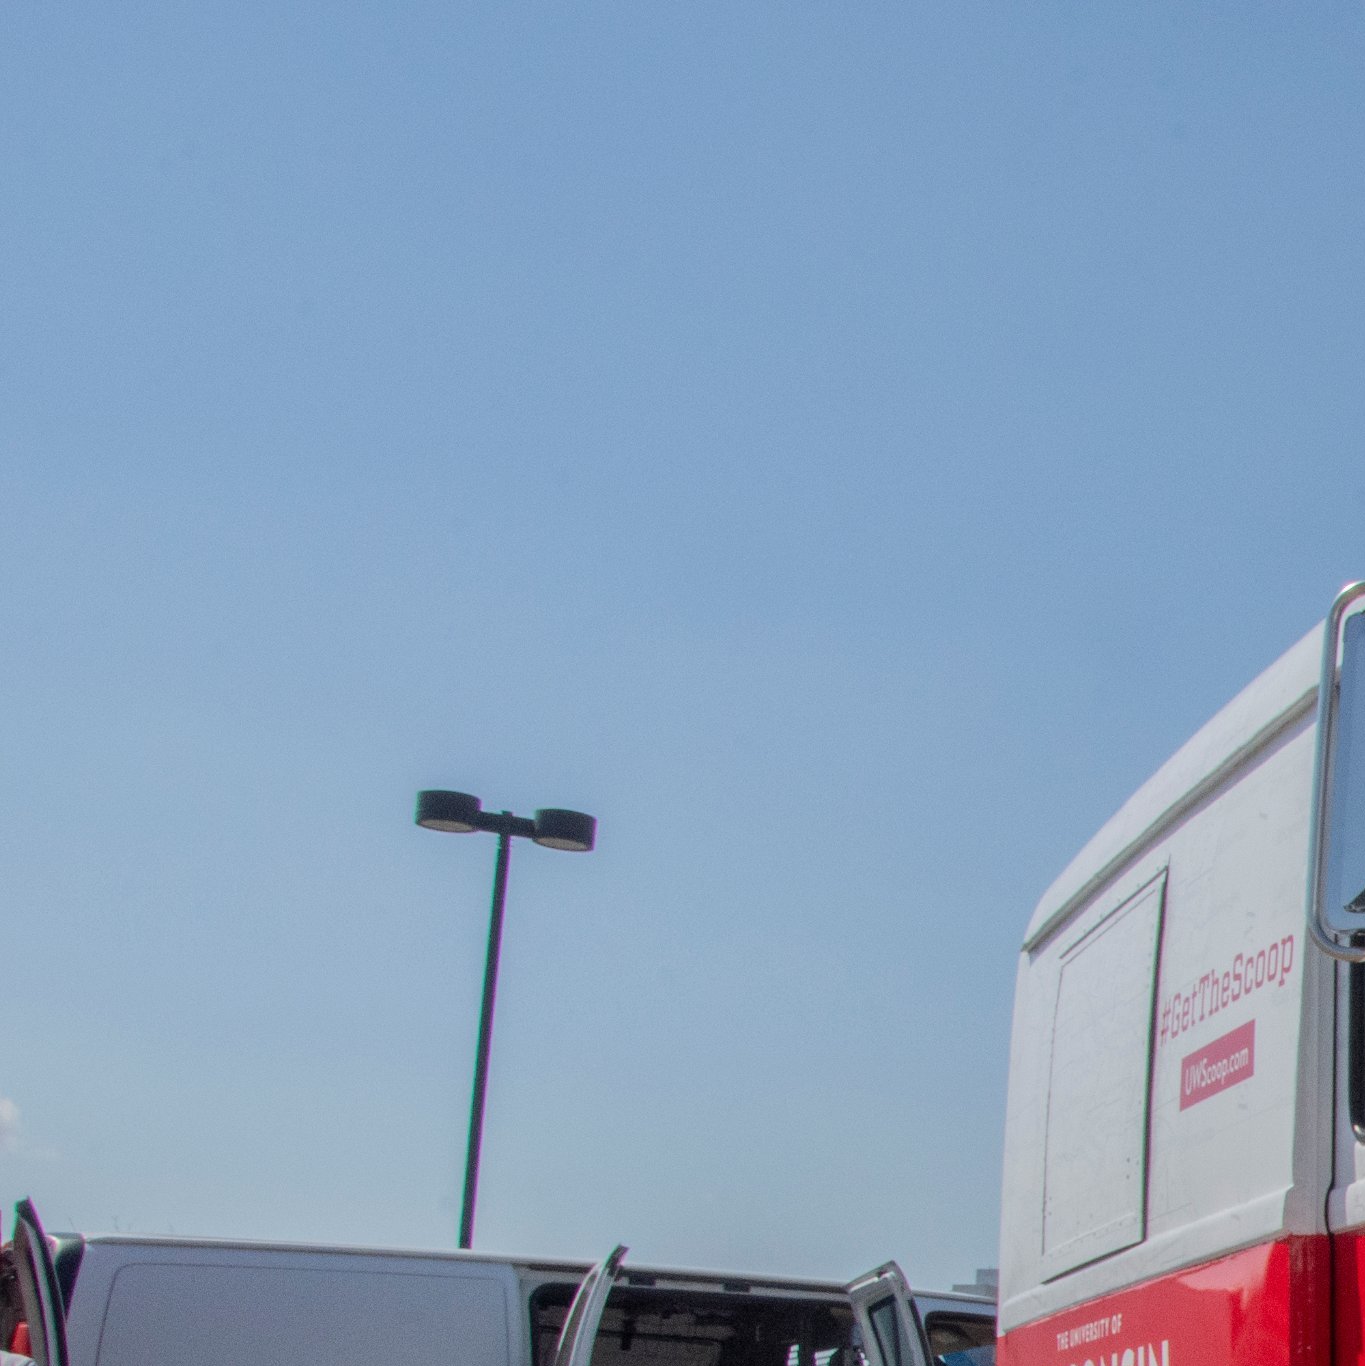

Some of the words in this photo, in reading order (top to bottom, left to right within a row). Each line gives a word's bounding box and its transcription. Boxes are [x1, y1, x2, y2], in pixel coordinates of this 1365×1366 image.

[1161, 934, 1294, 1047] #GetTheScoop
[1184, 1048, 1250, 1097] UWScoop.com
[1057, 1331, 1069, 1350] THE
[1070, 1318, 1109, 1347] UNIVERSITY
[1111, 1314, 1122, 1335] OF
